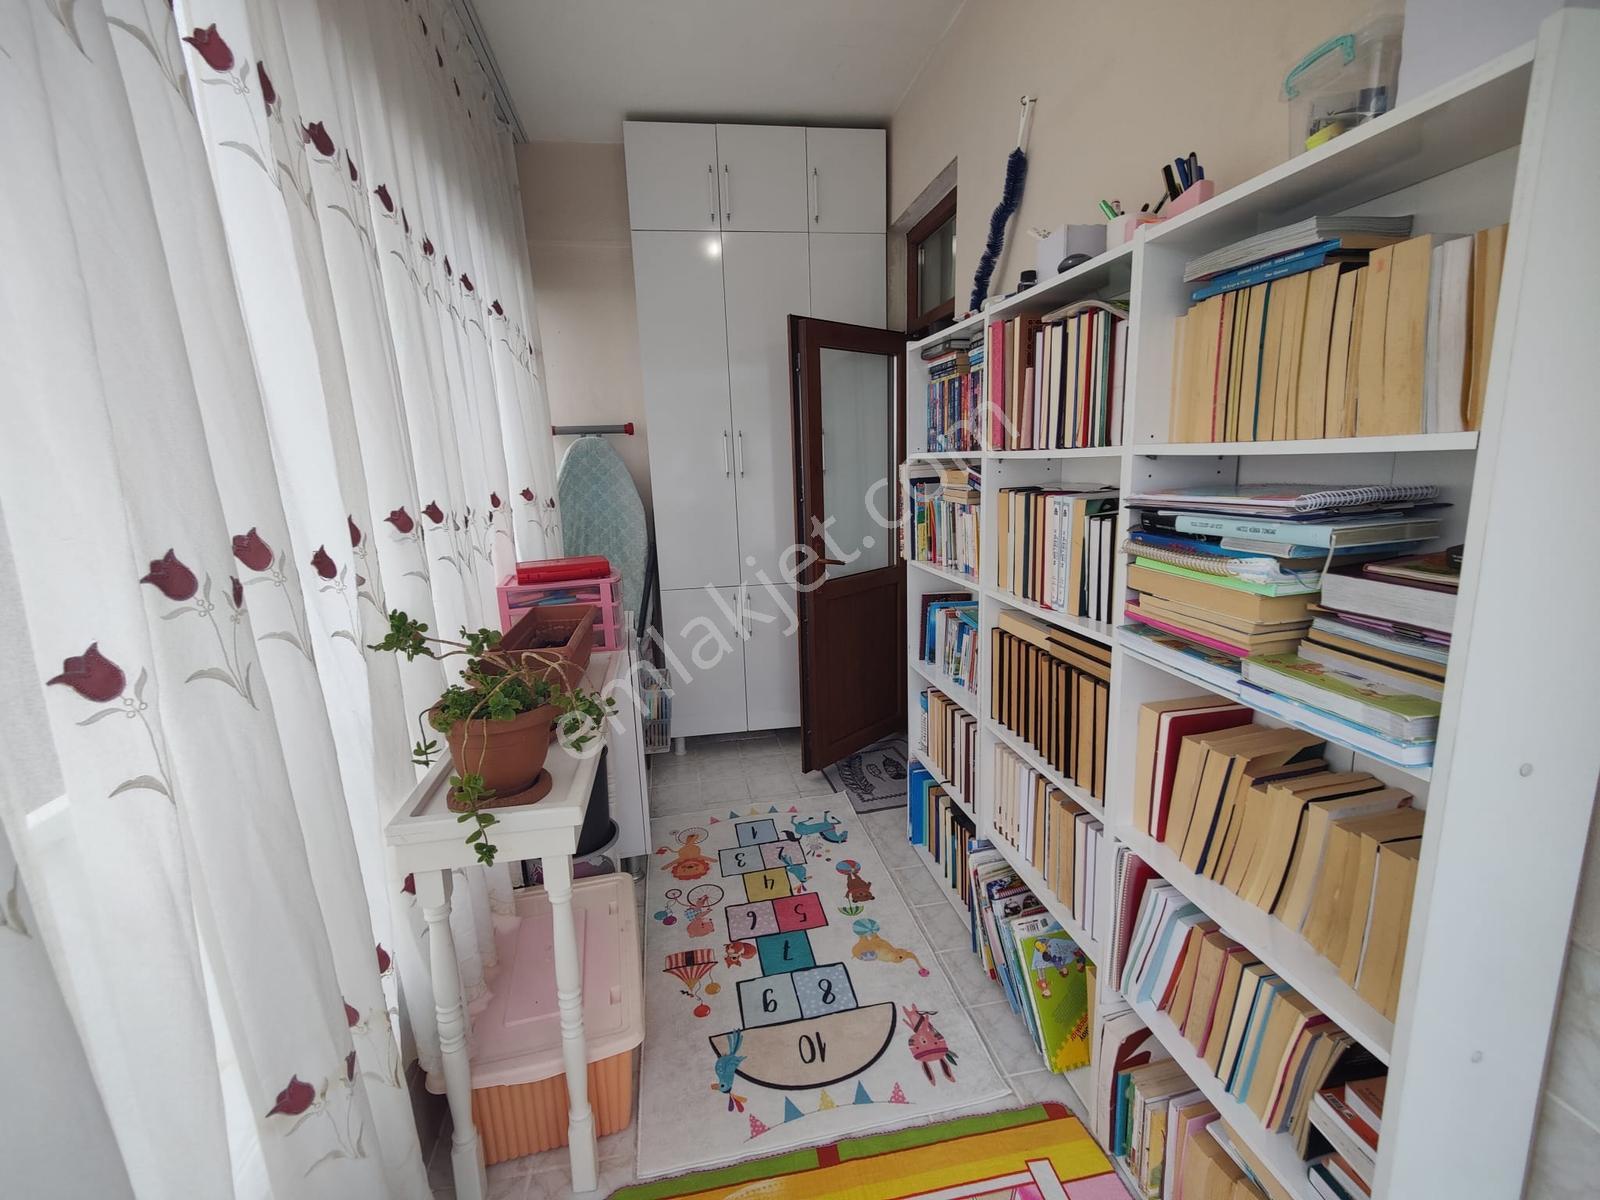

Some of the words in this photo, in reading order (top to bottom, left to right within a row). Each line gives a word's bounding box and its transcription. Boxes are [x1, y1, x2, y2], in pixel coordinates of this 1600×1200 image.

[751, 825, 758, 840] 1
[735, 852, 746, 867] 3
[776, 846, 784, 860] 2
[764, 874, 775, 891] 4
[747, 910, 757, 930] 6
[794, 903, 808, 922] 5
[783, 940, 793, 960] 7
[762, 988, 777, 1012] 9
[817, 979, 836, 1004] 8
[798, 1031, 827, 1064] 10
